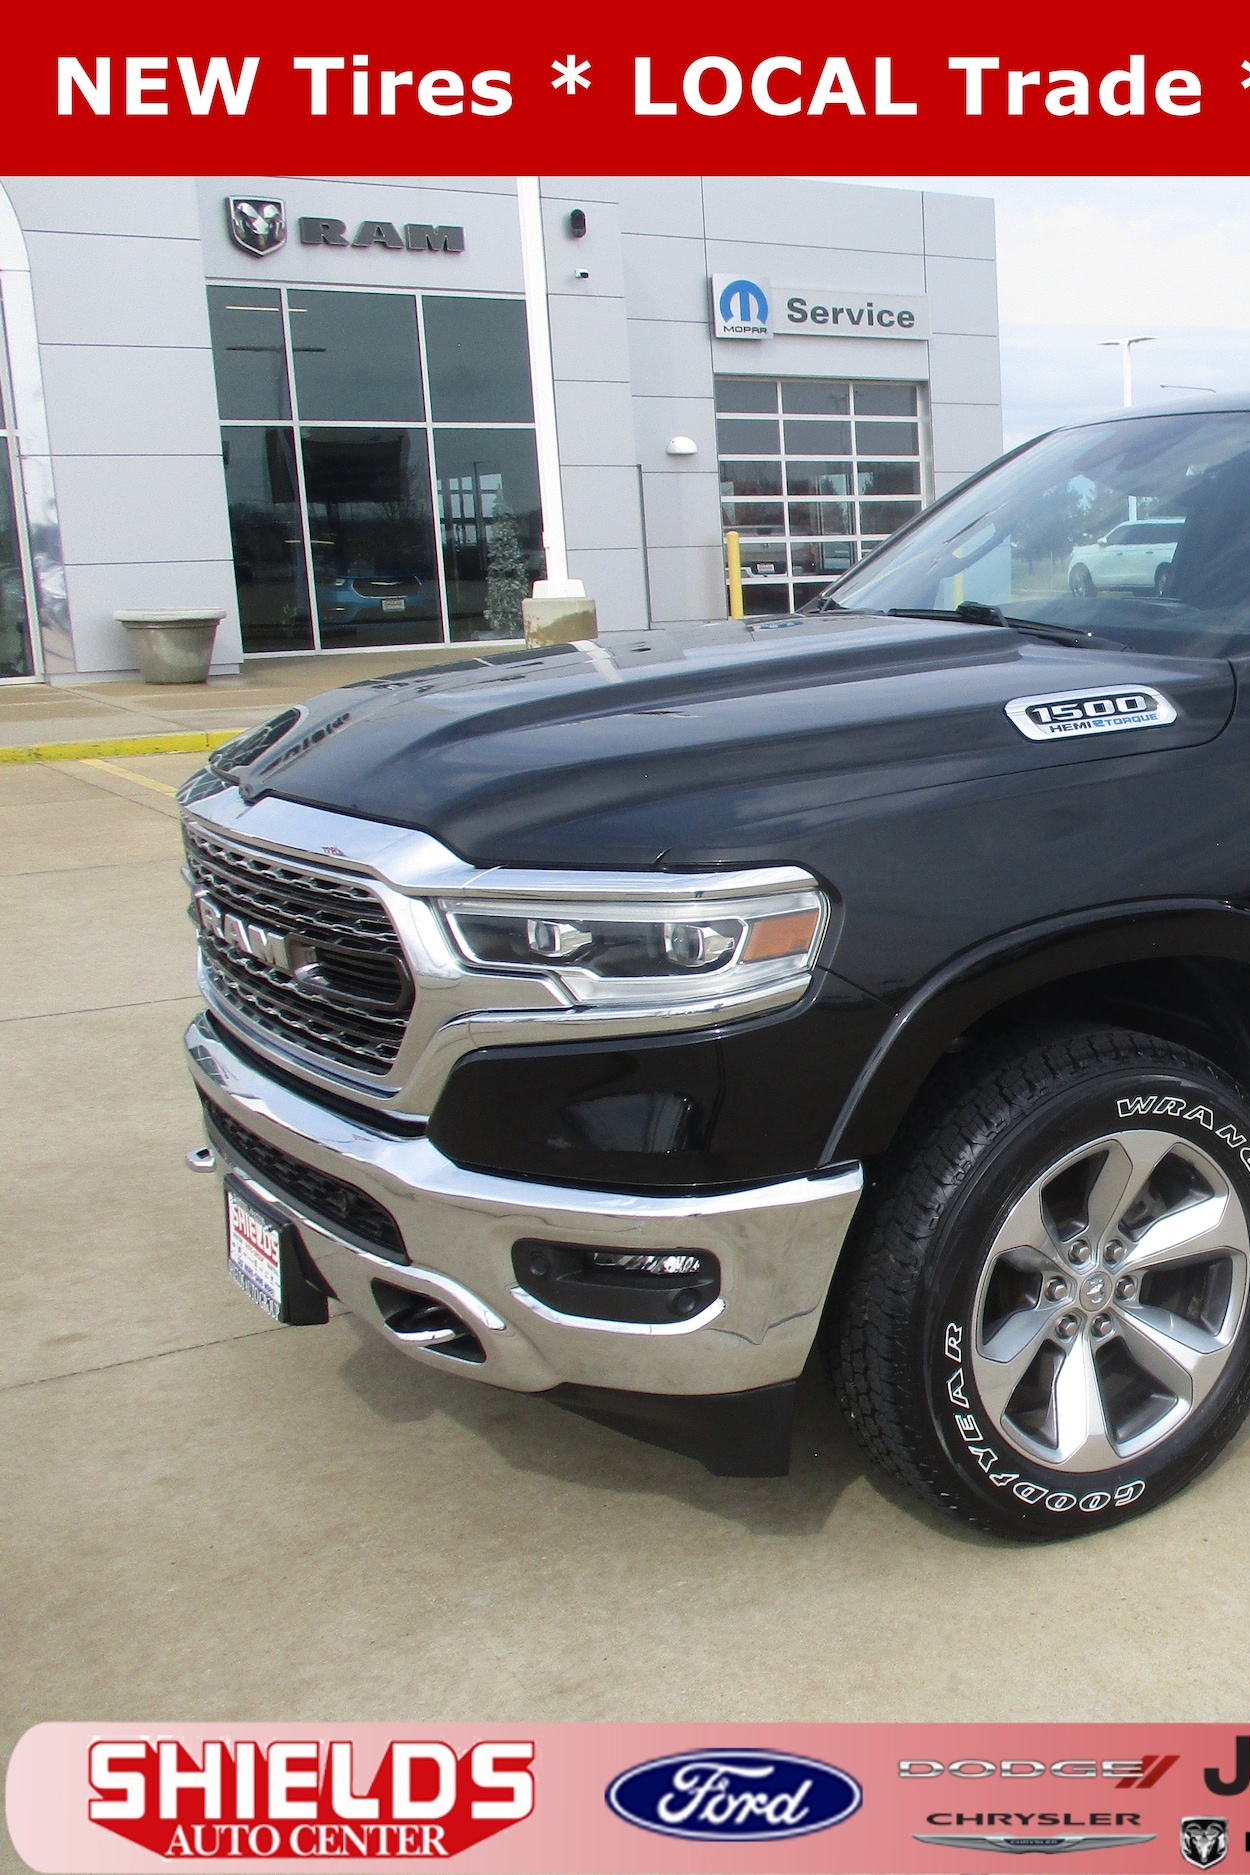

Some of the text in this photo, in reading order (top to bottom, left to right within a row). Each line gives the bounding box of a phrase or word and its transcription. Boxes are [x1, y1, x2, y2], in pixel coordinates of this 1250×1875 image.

[299, 216, 465, 253] RAM
[723, 325, 768, 334] MOPAR
[786, 297, 915, 328] Service
[1032, 695, 1148, 723] 1500
[1049, 721, 1092, 734] HEMI
[200, 898, 291, 970] RAM
[231, 1203, 279, 1265] SHIELDS
[944, 1321, 1146, 1513] GOODYEAR
